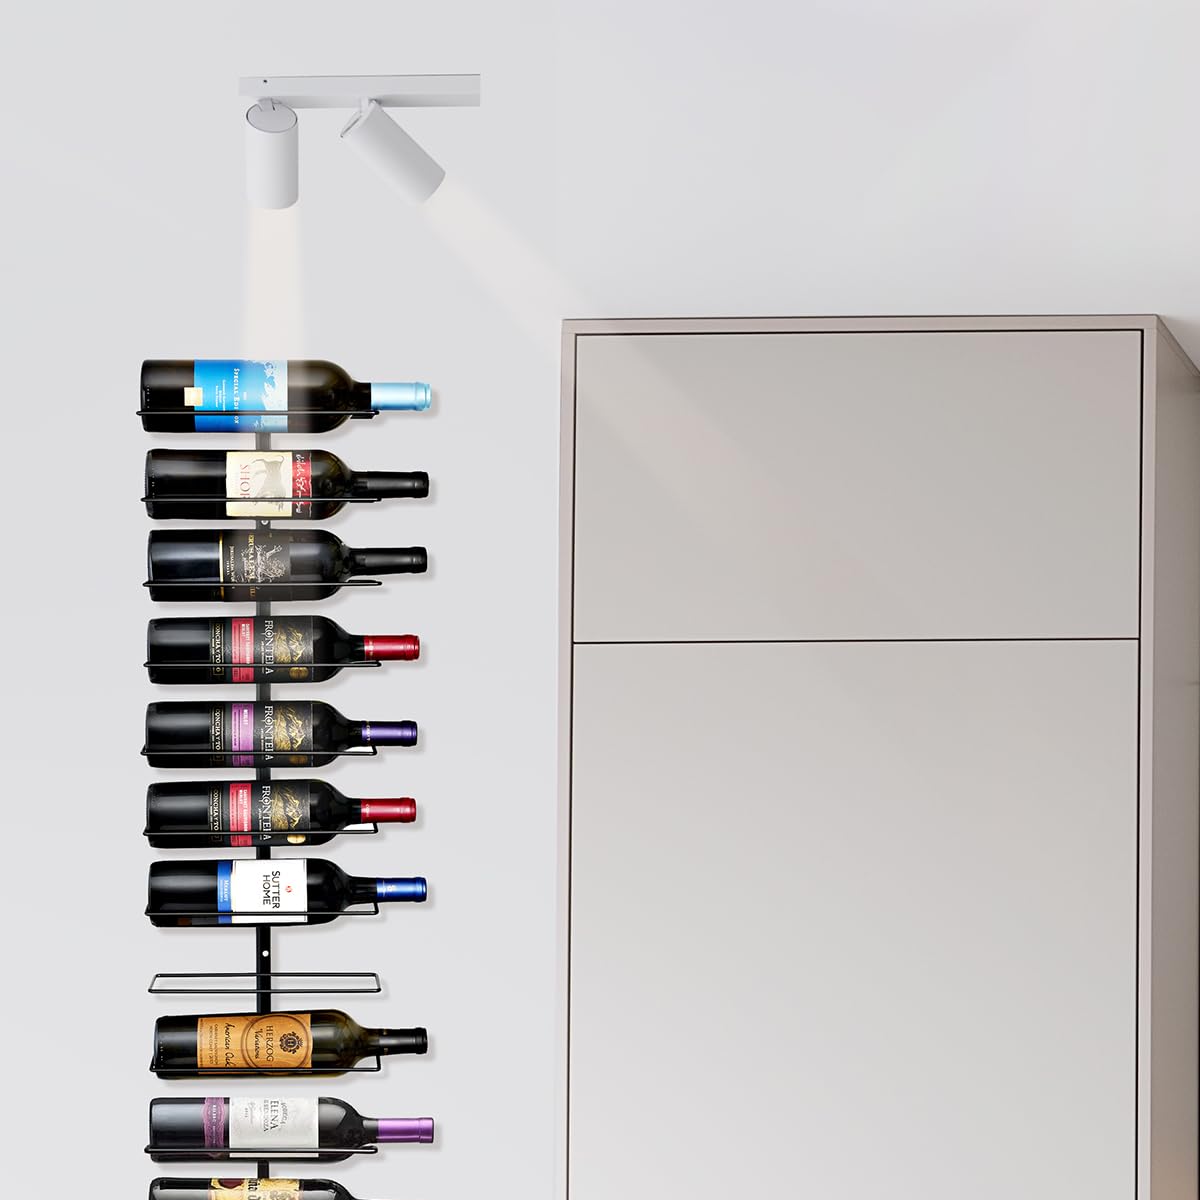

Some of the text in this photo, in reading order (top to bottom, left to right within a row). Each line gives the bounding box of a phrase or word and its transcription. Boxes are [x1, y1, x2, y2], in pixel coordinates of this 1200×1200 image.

[233, 368, 241, 395] SPECIAL
[262, 874, 272, 905] HOME
[271, 870, 281, 909] SUTTER
[224, 1022, 236, 1067] American Oak
[265, 1025, 274, 1062] HERZOG
[270, 1100, 280, 1130] ELENA
